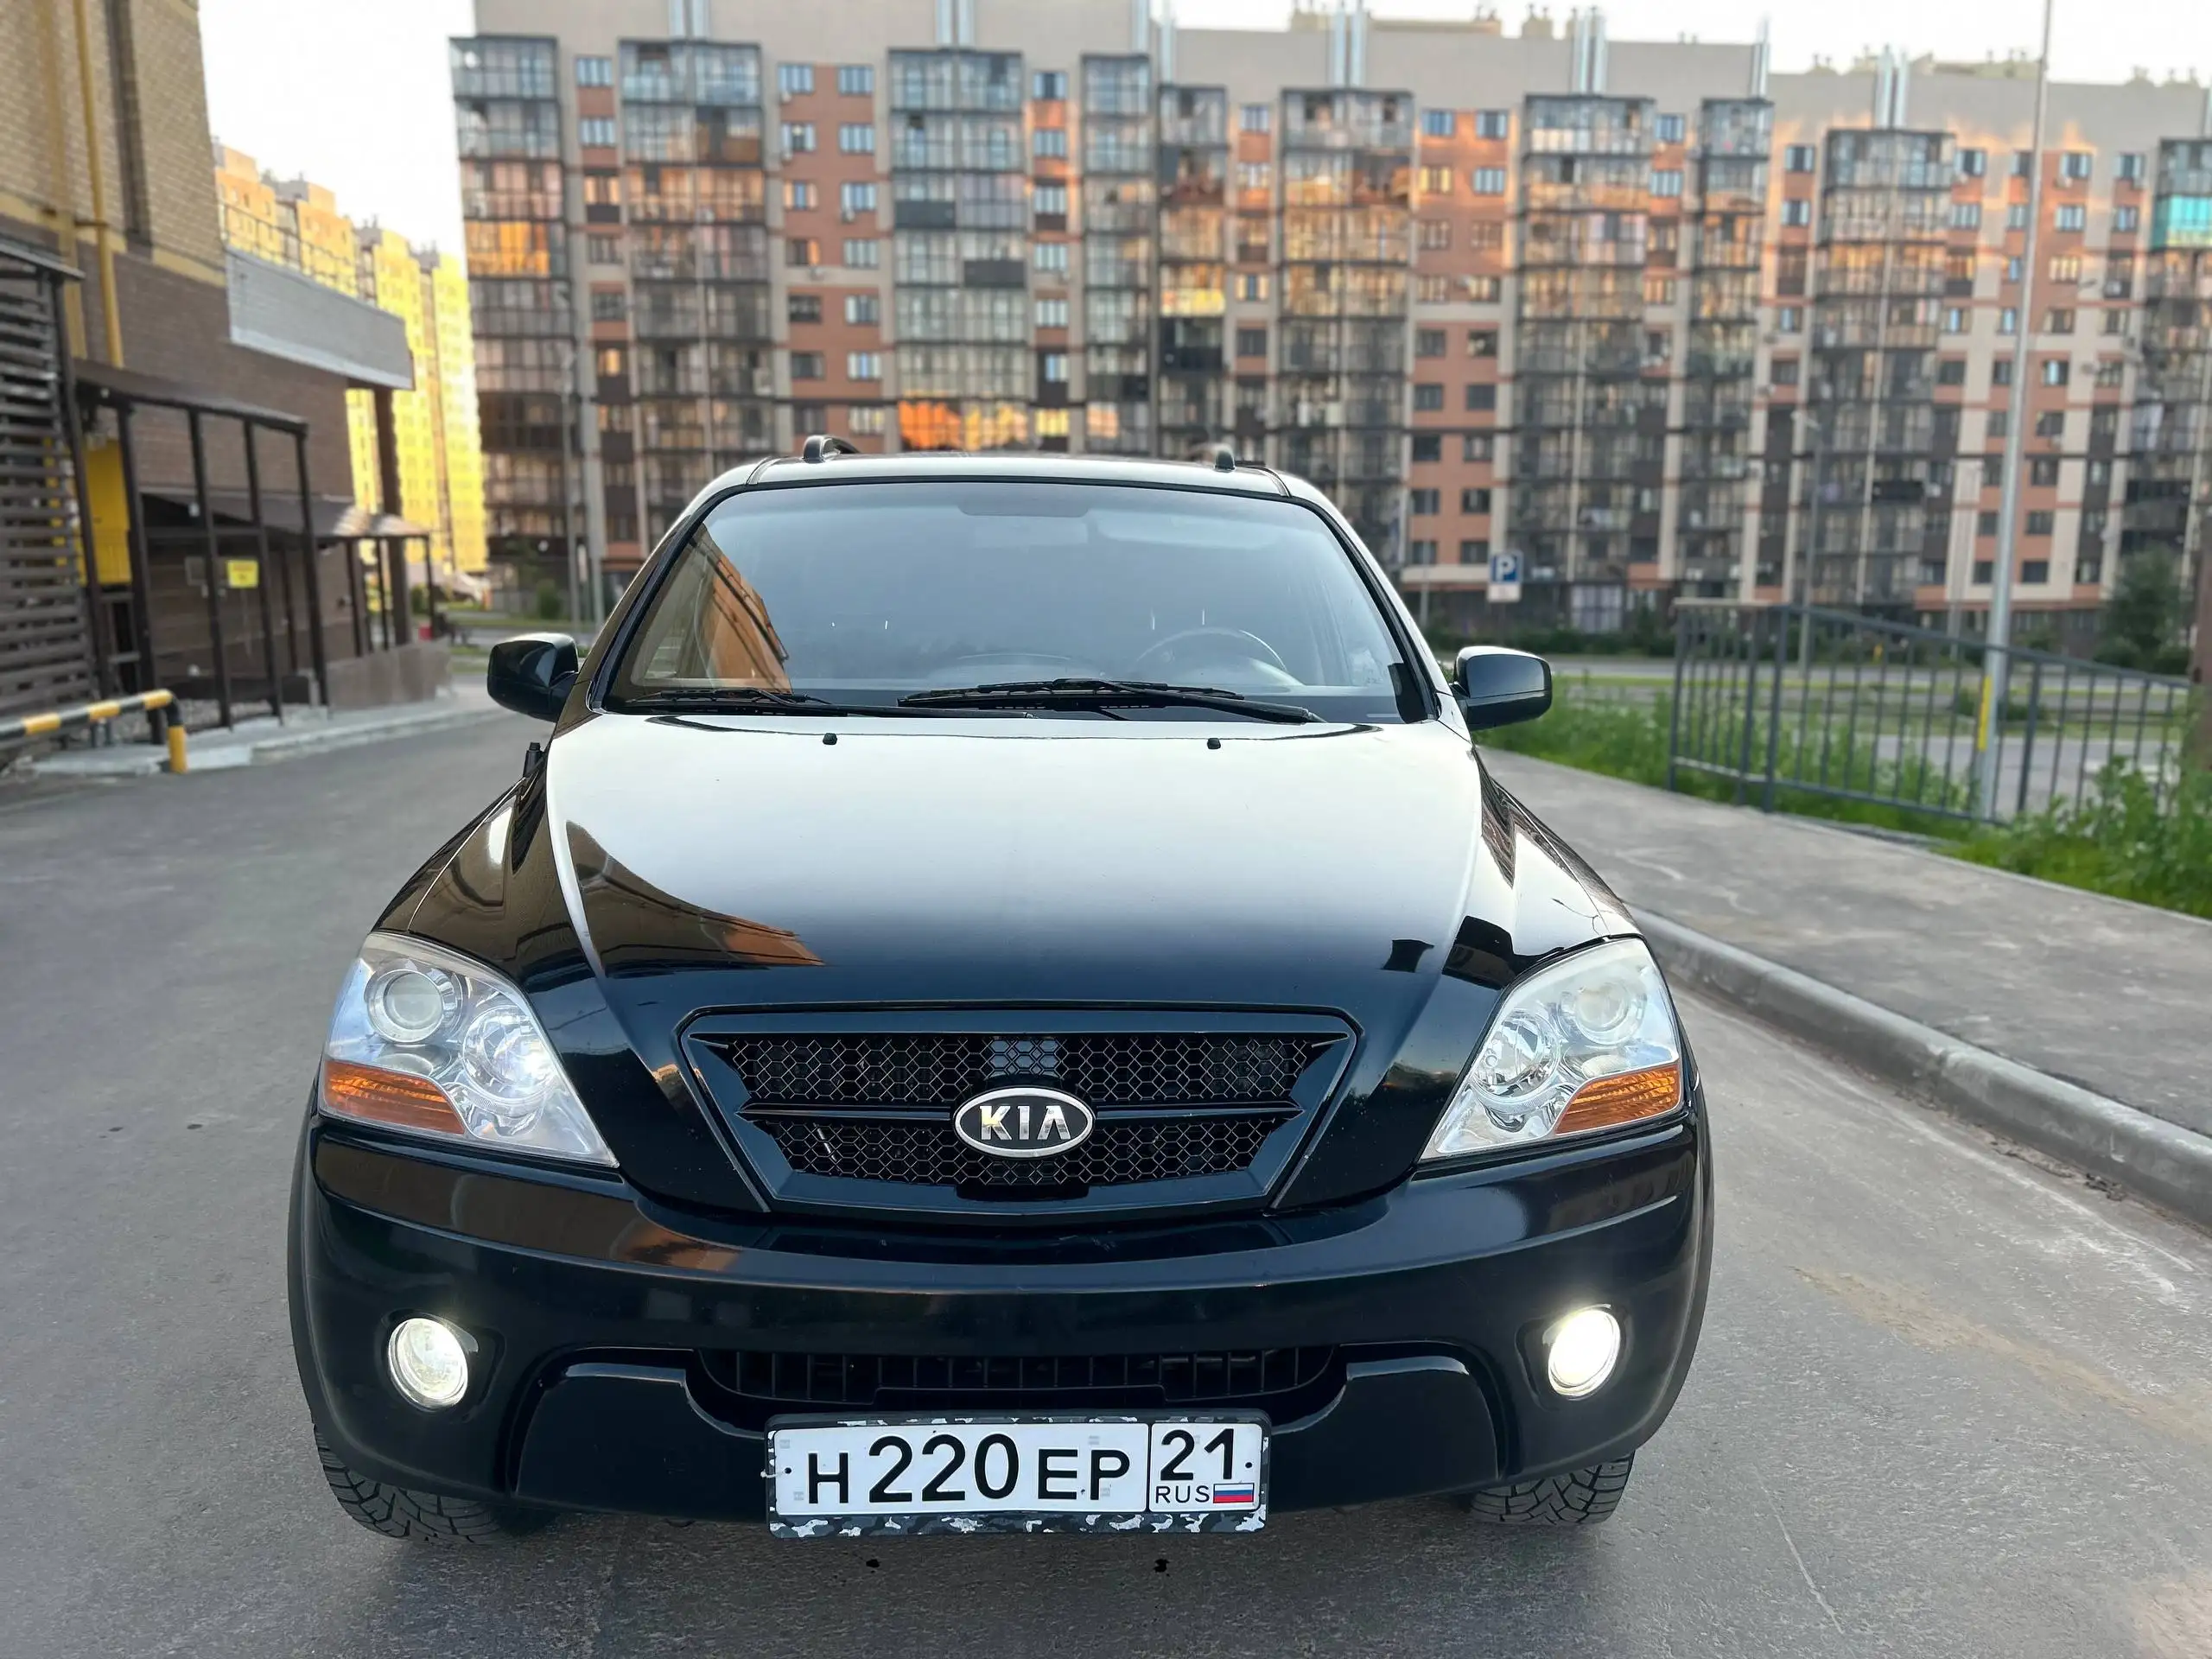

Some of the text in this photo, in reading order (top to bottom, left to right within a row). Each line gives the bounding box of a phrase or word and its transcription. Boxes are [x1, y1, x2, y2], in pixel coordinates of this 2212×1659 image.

[1496, 555, 1516, 582] P
[979, 1105, 1071, 1141] KIA
[1160, 1427, 1235, 1481] 21
[1155, 1484, 1211, 1504] RUS
